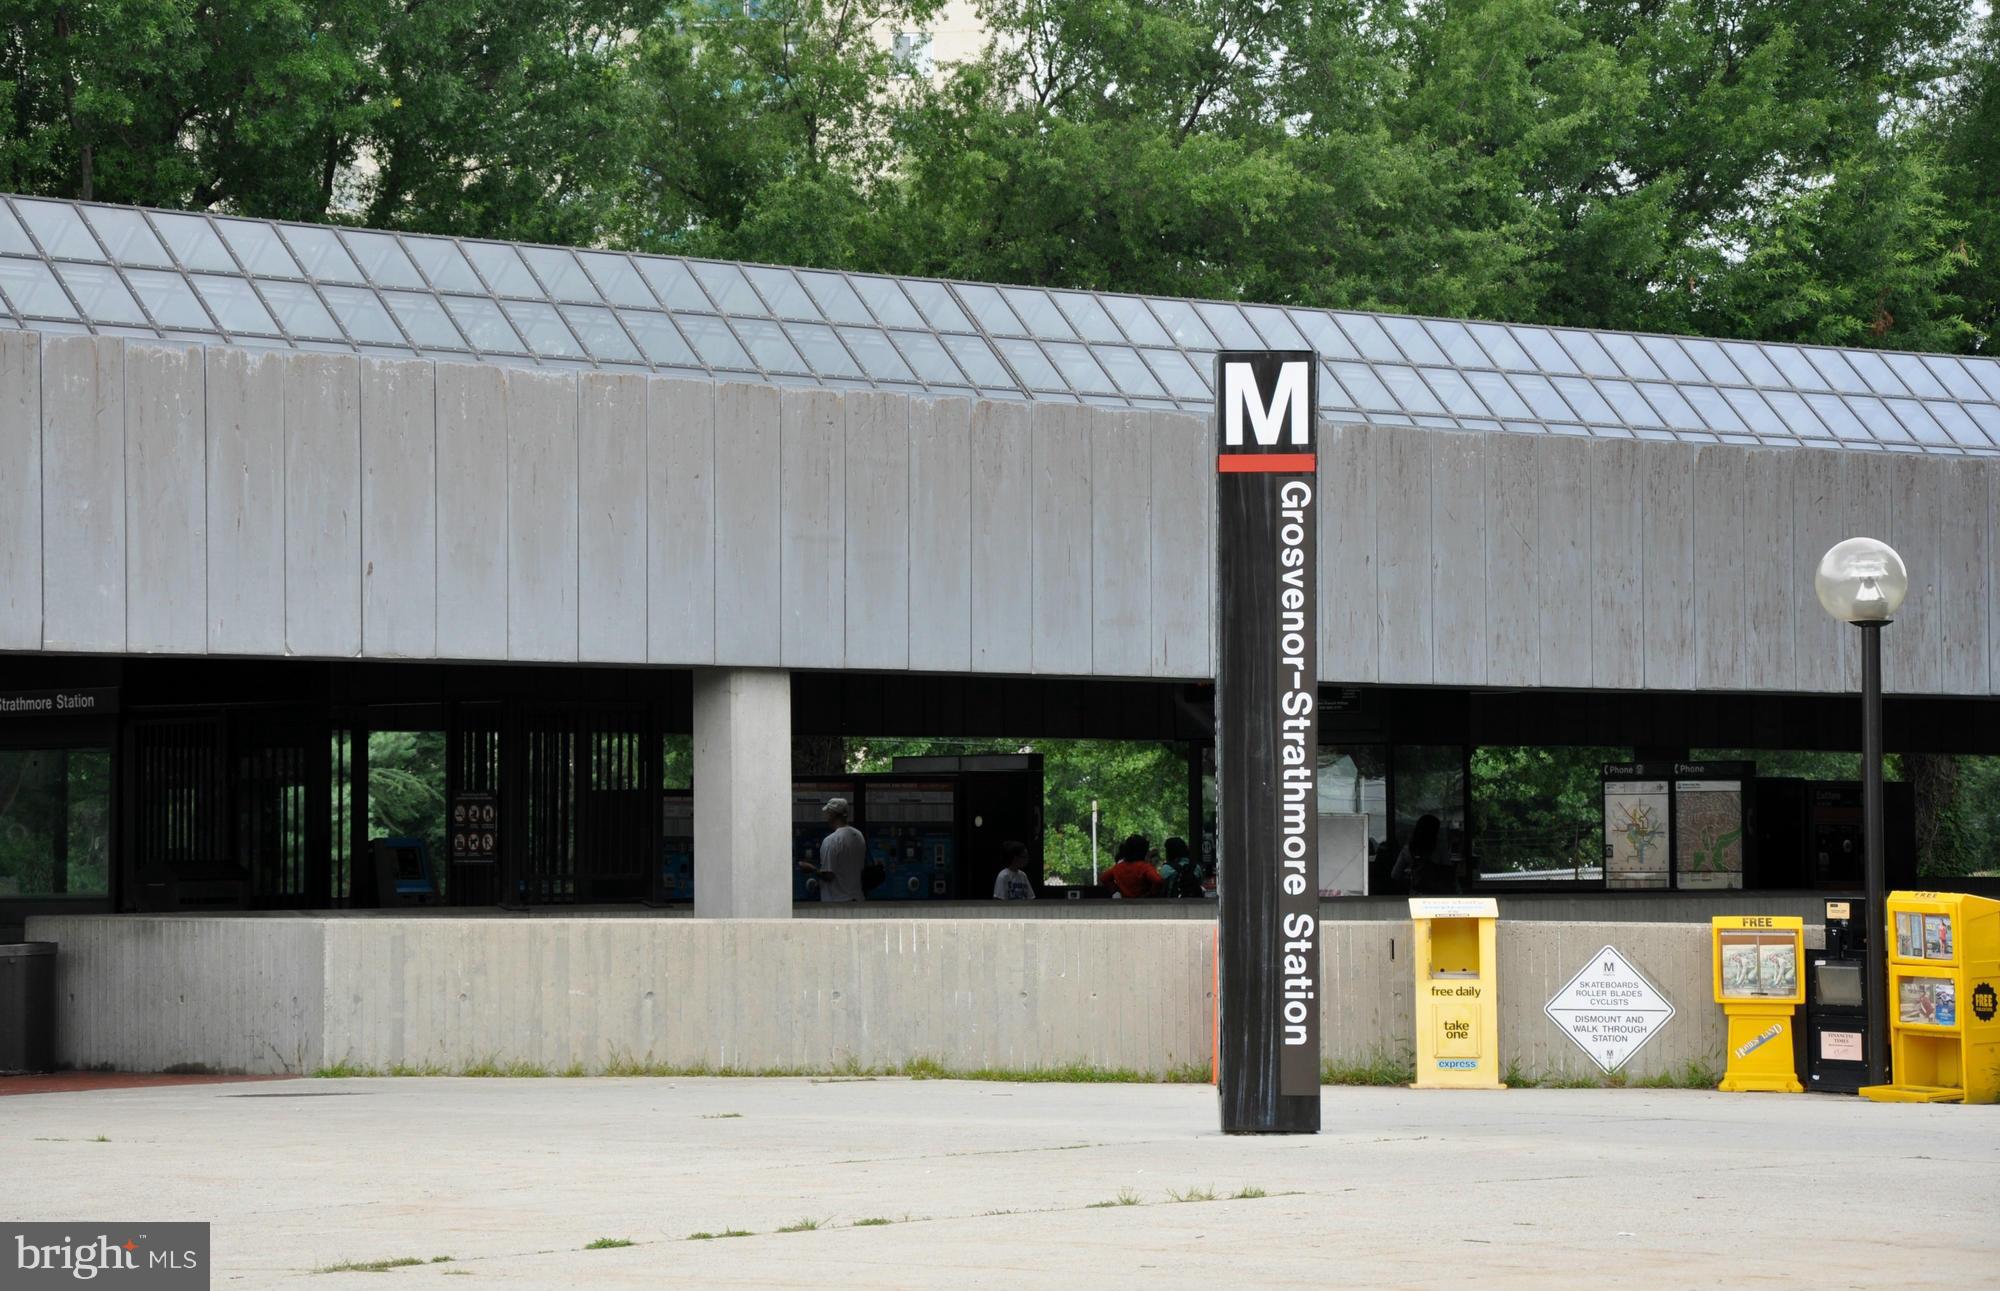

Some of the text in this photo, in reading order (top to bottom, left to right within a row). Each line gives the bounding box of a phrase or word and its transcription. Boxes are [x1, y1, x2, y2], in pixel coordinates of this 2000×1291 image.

[1225, 361, 1309, 446] M
[56, 693, 95, 709] Station
[1280, 480, 1315, 1046] Grosvenor-Strathmore Station
[1609, 765, 1634, 774] Phone
[1680, 764, 1705, 773] Phone
[1742, 917, 1773, 928] FREE
[1604, 962, 1615, 972] M
[1579, 981, 1639, 989] SKATEBOARDS
[1431, 985, 1482, 999] free daily
[1575, 989, 1643, 998] ROLLER BLADES
[1589, 998, 1629, 1006] CYCLISTS
[1975, 993, 1993, 1007] FREE
[1574, 1015, 1645, 1024] DISMOUNT AND
[1444, 1020, 1470, 1031] take
[1573, 1025, 1647, 1034] WALK THROUGH
[1446, 1031, 1469, 1039] one
[1591, 1034, 1629, 1043] STATION
[1438, 1060, 1477, 1069] express
